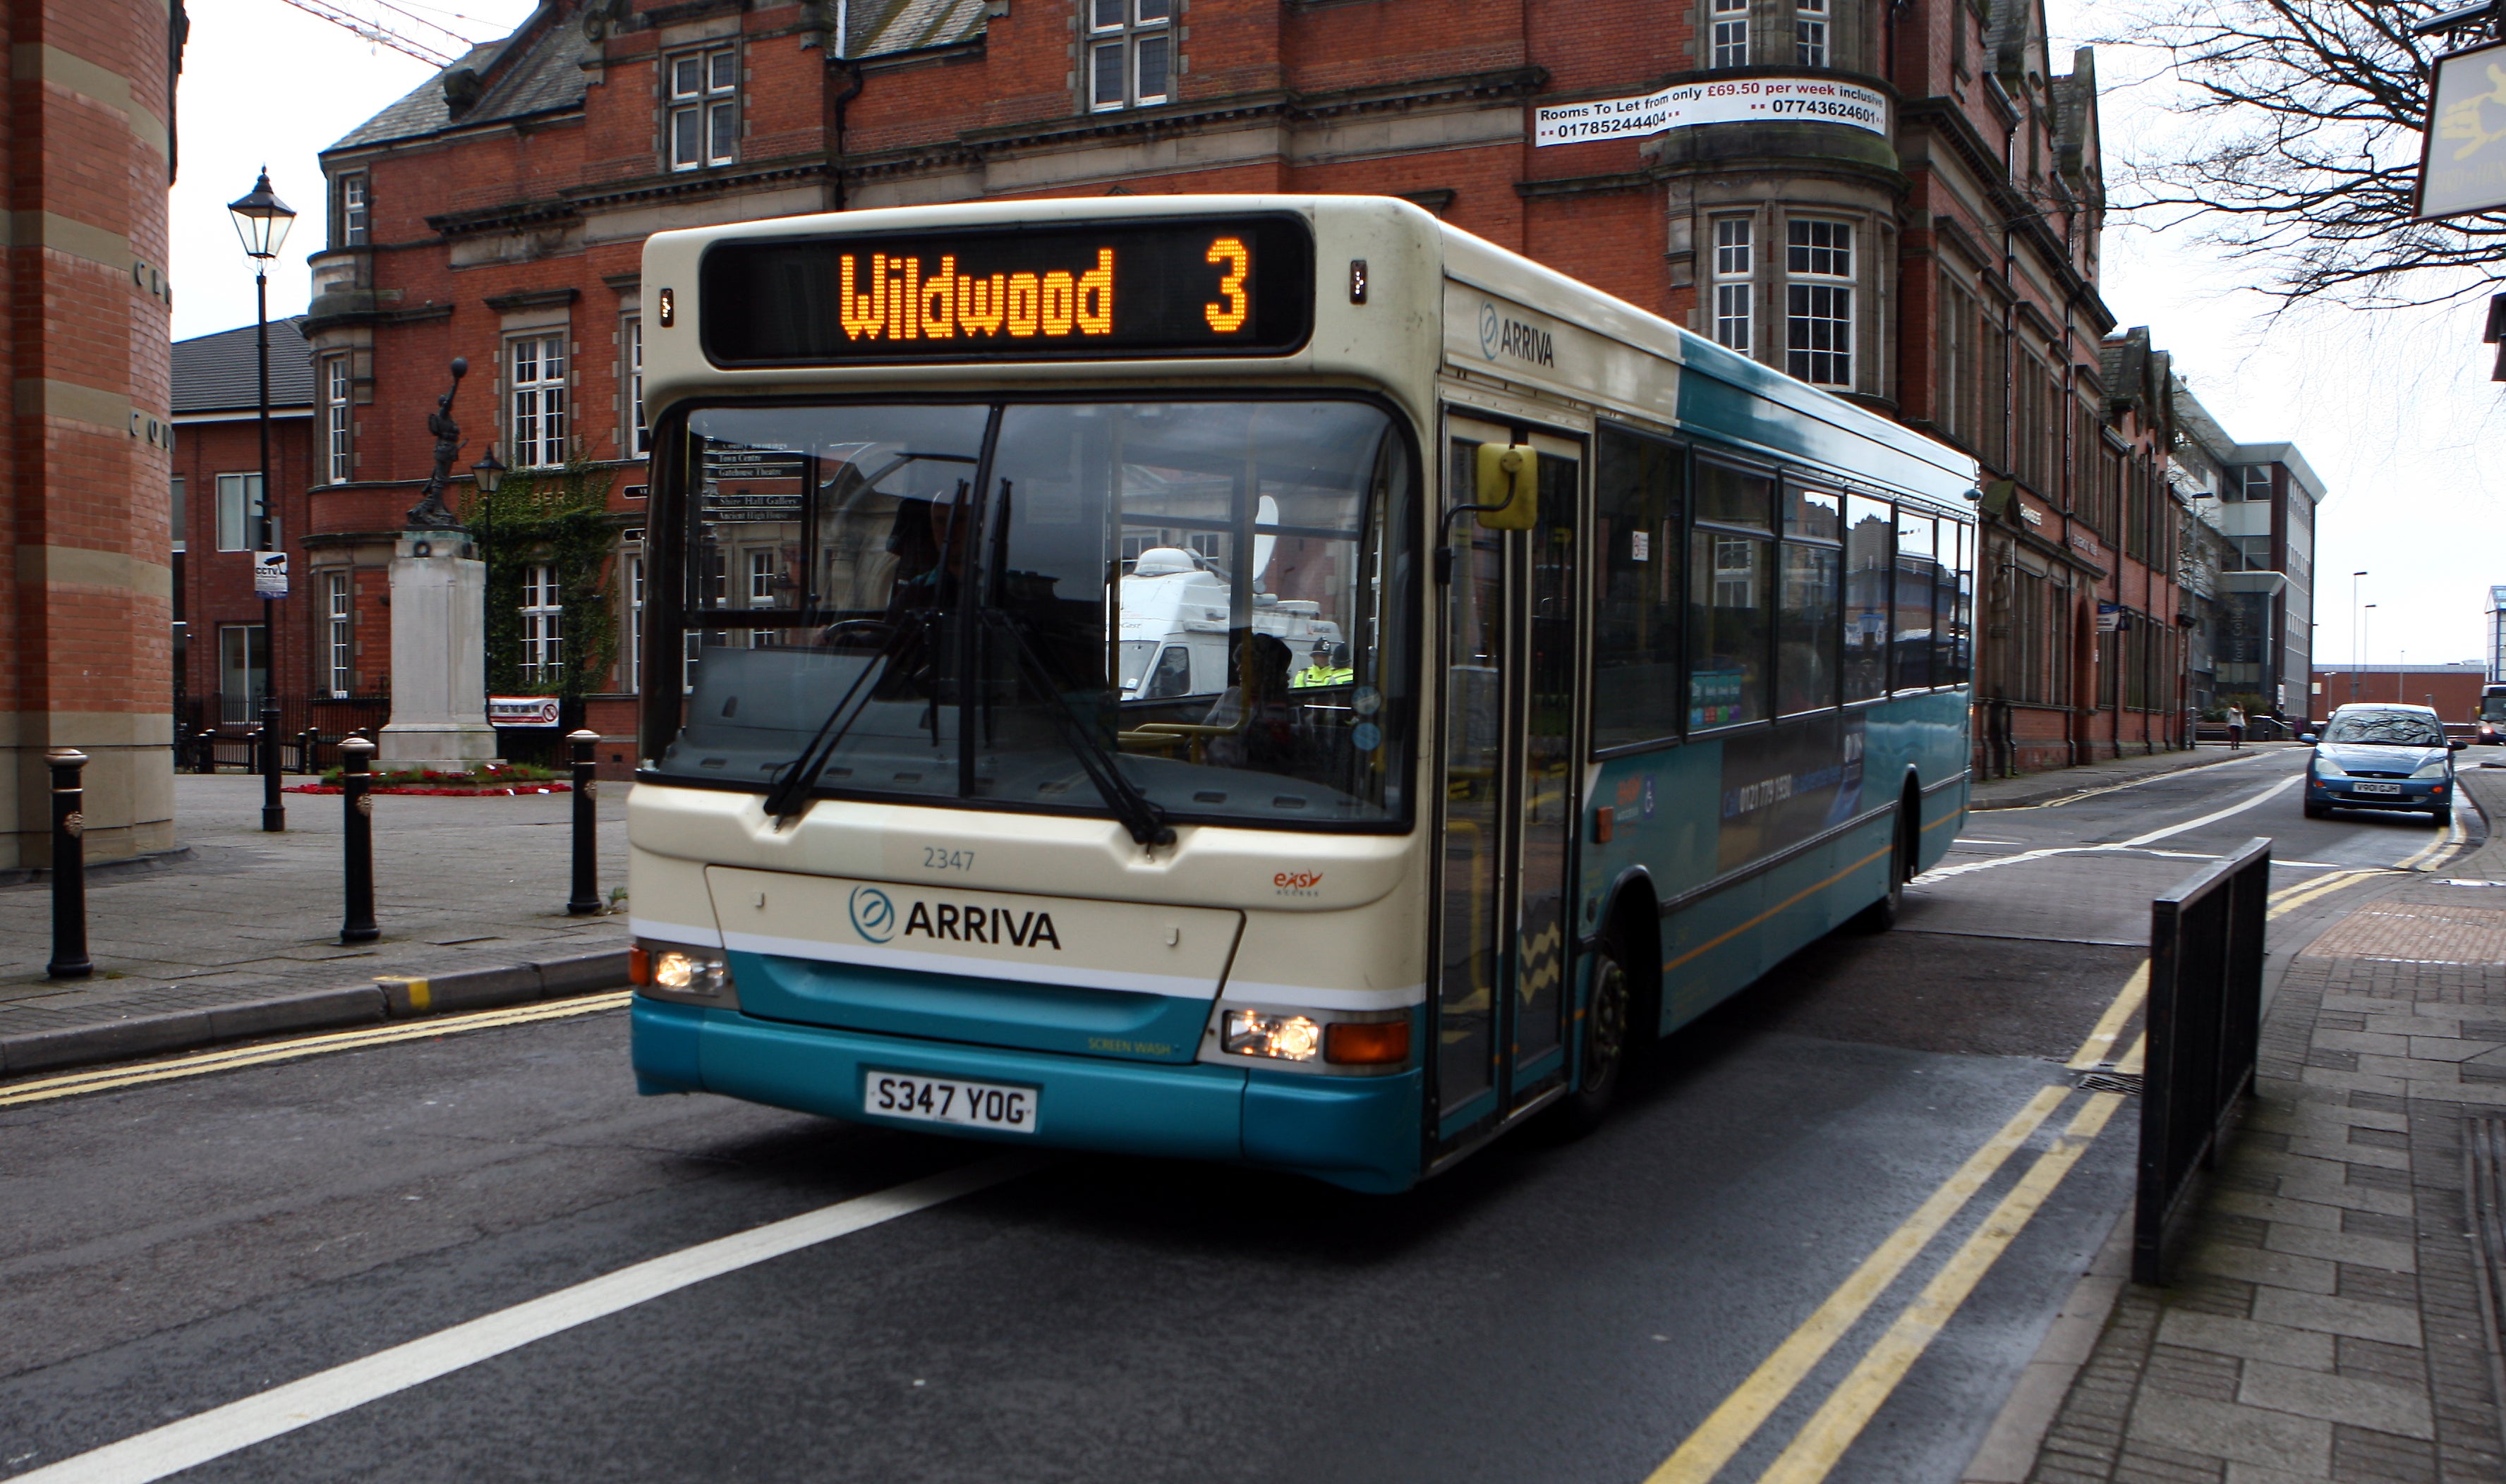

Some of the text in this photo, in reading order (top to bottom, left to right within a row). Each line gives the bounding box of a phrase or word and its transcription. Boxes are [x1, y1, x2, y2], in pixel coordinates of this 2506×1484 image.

[1541, 83, 1884, 121] Rooms To Let from only £69.50 per week inclusive
[1772, 99, 1876, 124] 07743624601
[1558, 110, 1666, 138] 01785244404
[841, 238, 1247, 341] Wildwood 3
[1501, 318, 1554, 368] ARRIVA
[720, 497, 797, 506] Shire Hall Gallery
[924, 847, 975, 871] 2347
[904, 901, 1061, 950] ARRIVA
[1088, 1036, 1172, 1055] SCREEN WASH
[879, 1079, 1024, 1124] S347 YOG
